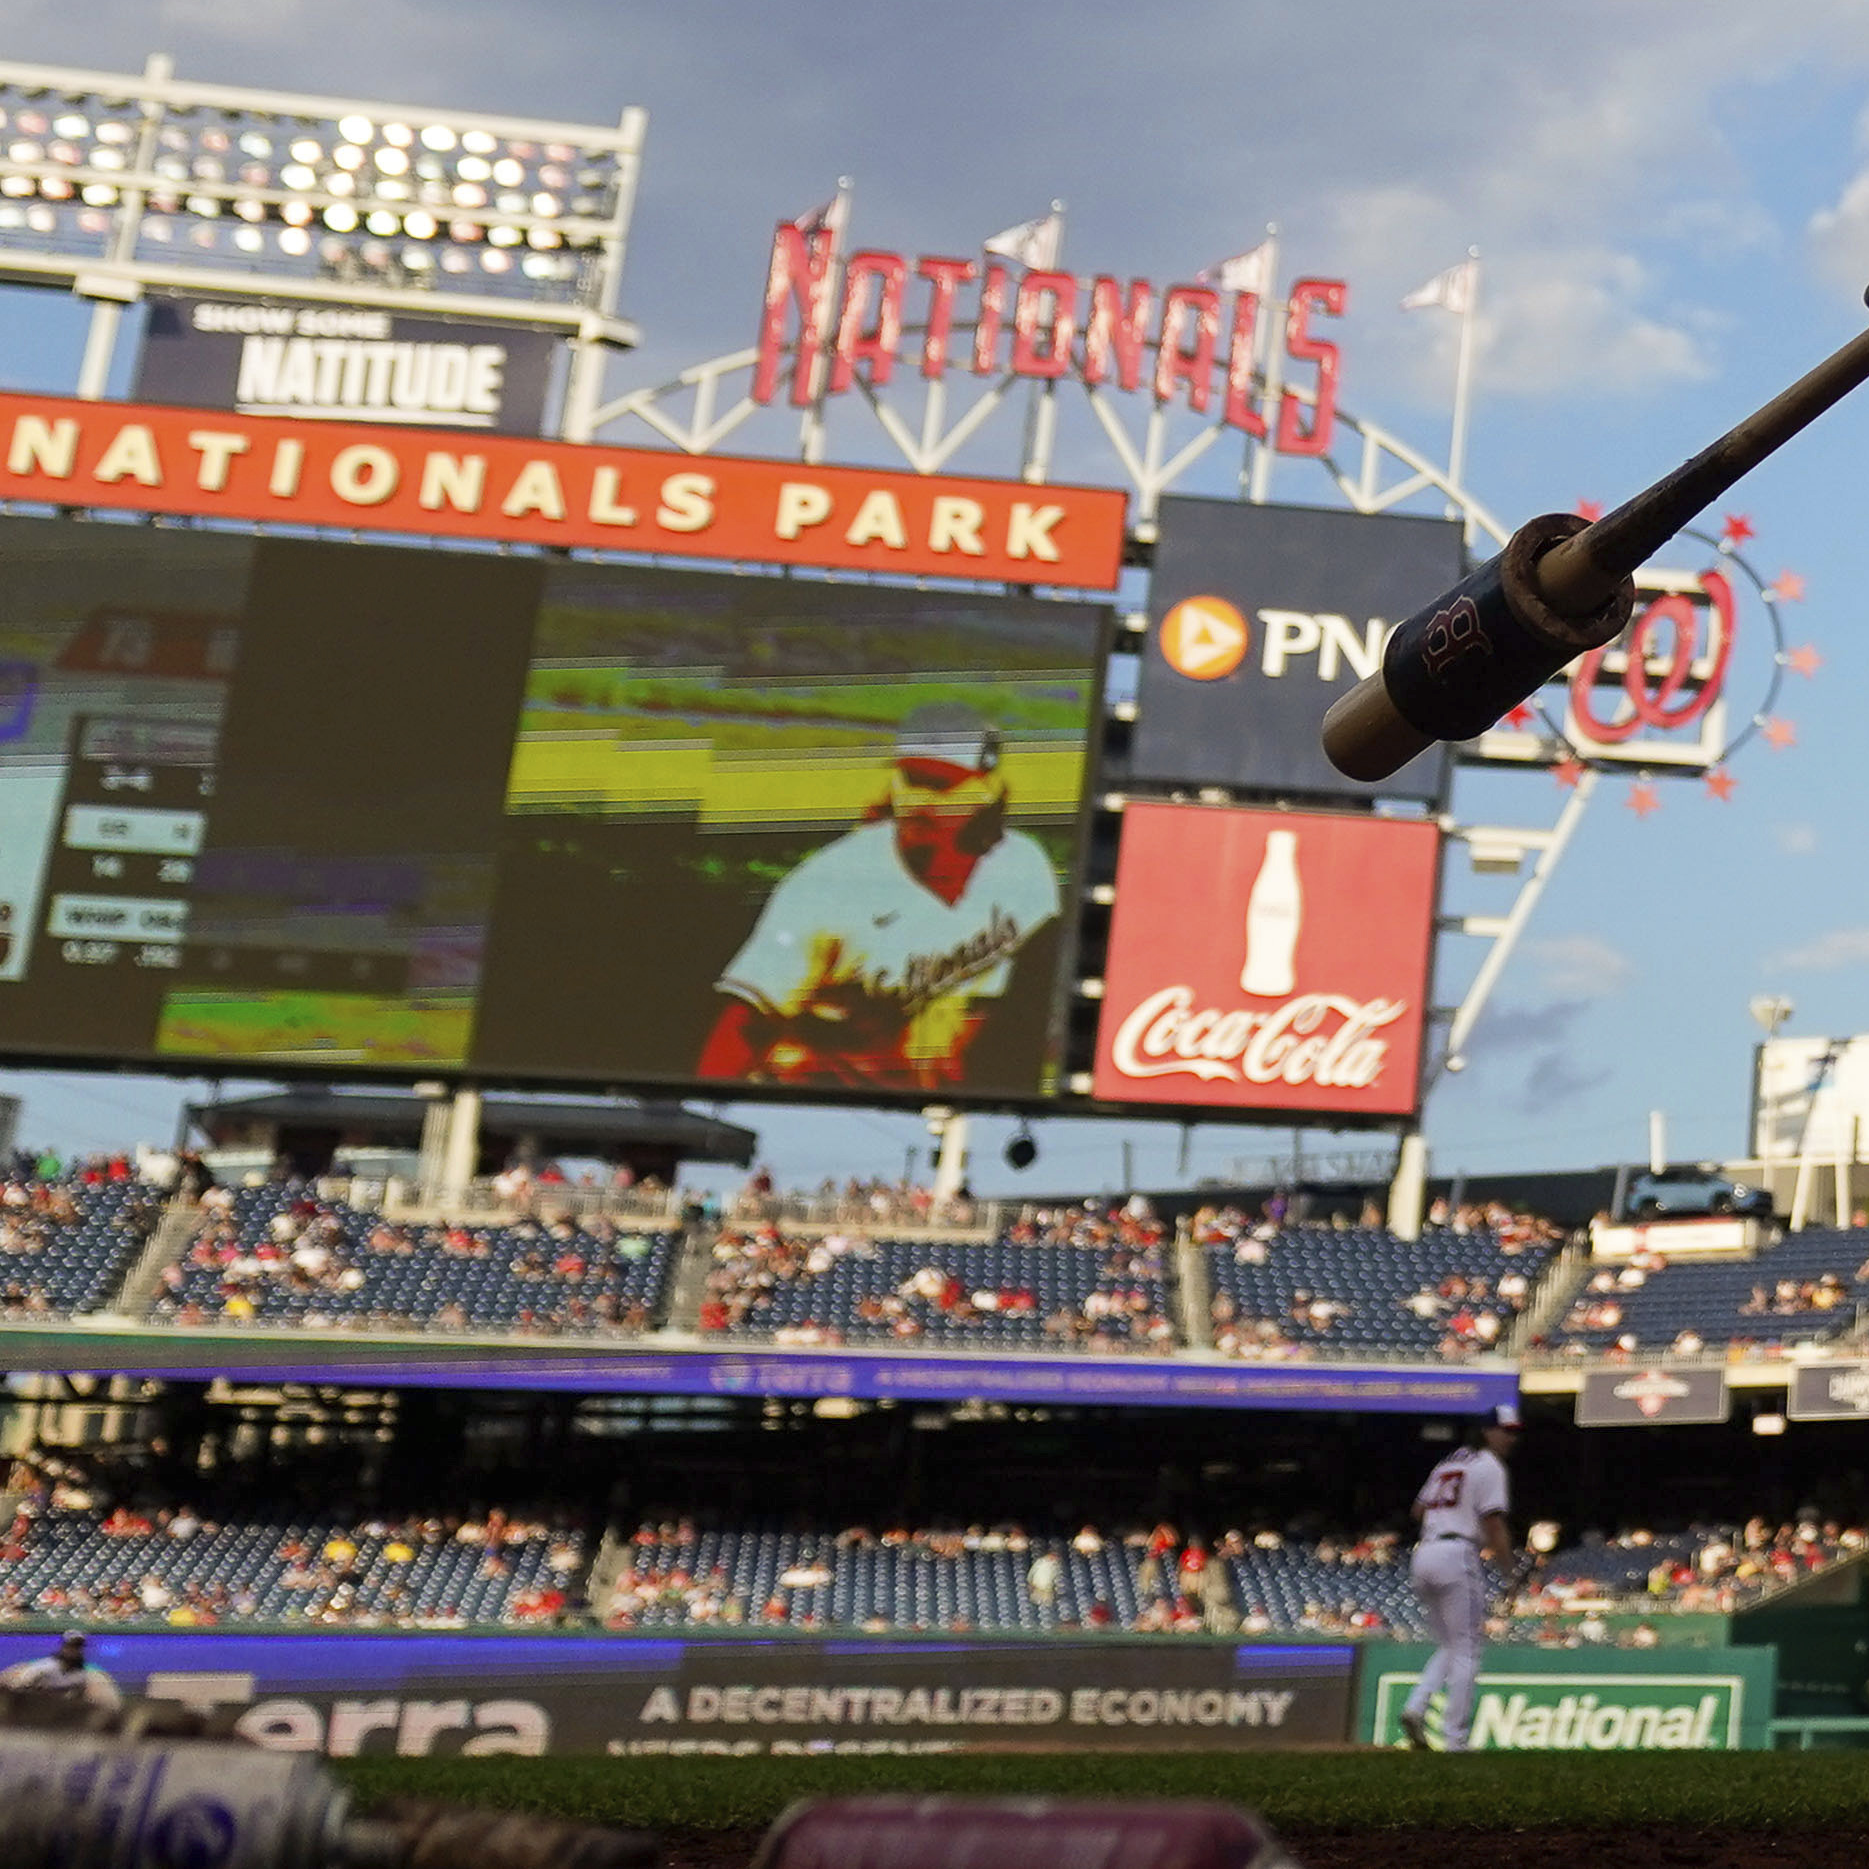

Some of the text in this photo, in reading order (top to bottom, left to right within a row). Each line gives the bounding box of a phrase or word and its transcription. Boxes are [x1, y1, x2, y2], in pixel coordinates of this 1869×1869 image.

[236, 335, 507, 413] NATITUDE
[753, 220, 1348, 458] NATIONALS
[7, 415, 1066, 562] NATIONALS PARK
[1257, 607, 1390, 682] PN
[1112, 984, 1408, 1089] Coca-Cola
[145, 1672, 552, 1757] Terra
[638, 1685, 1296, 1727] A DECENTRALIZED ECONOMY
[1468, 1693, 1721, 1750] National
